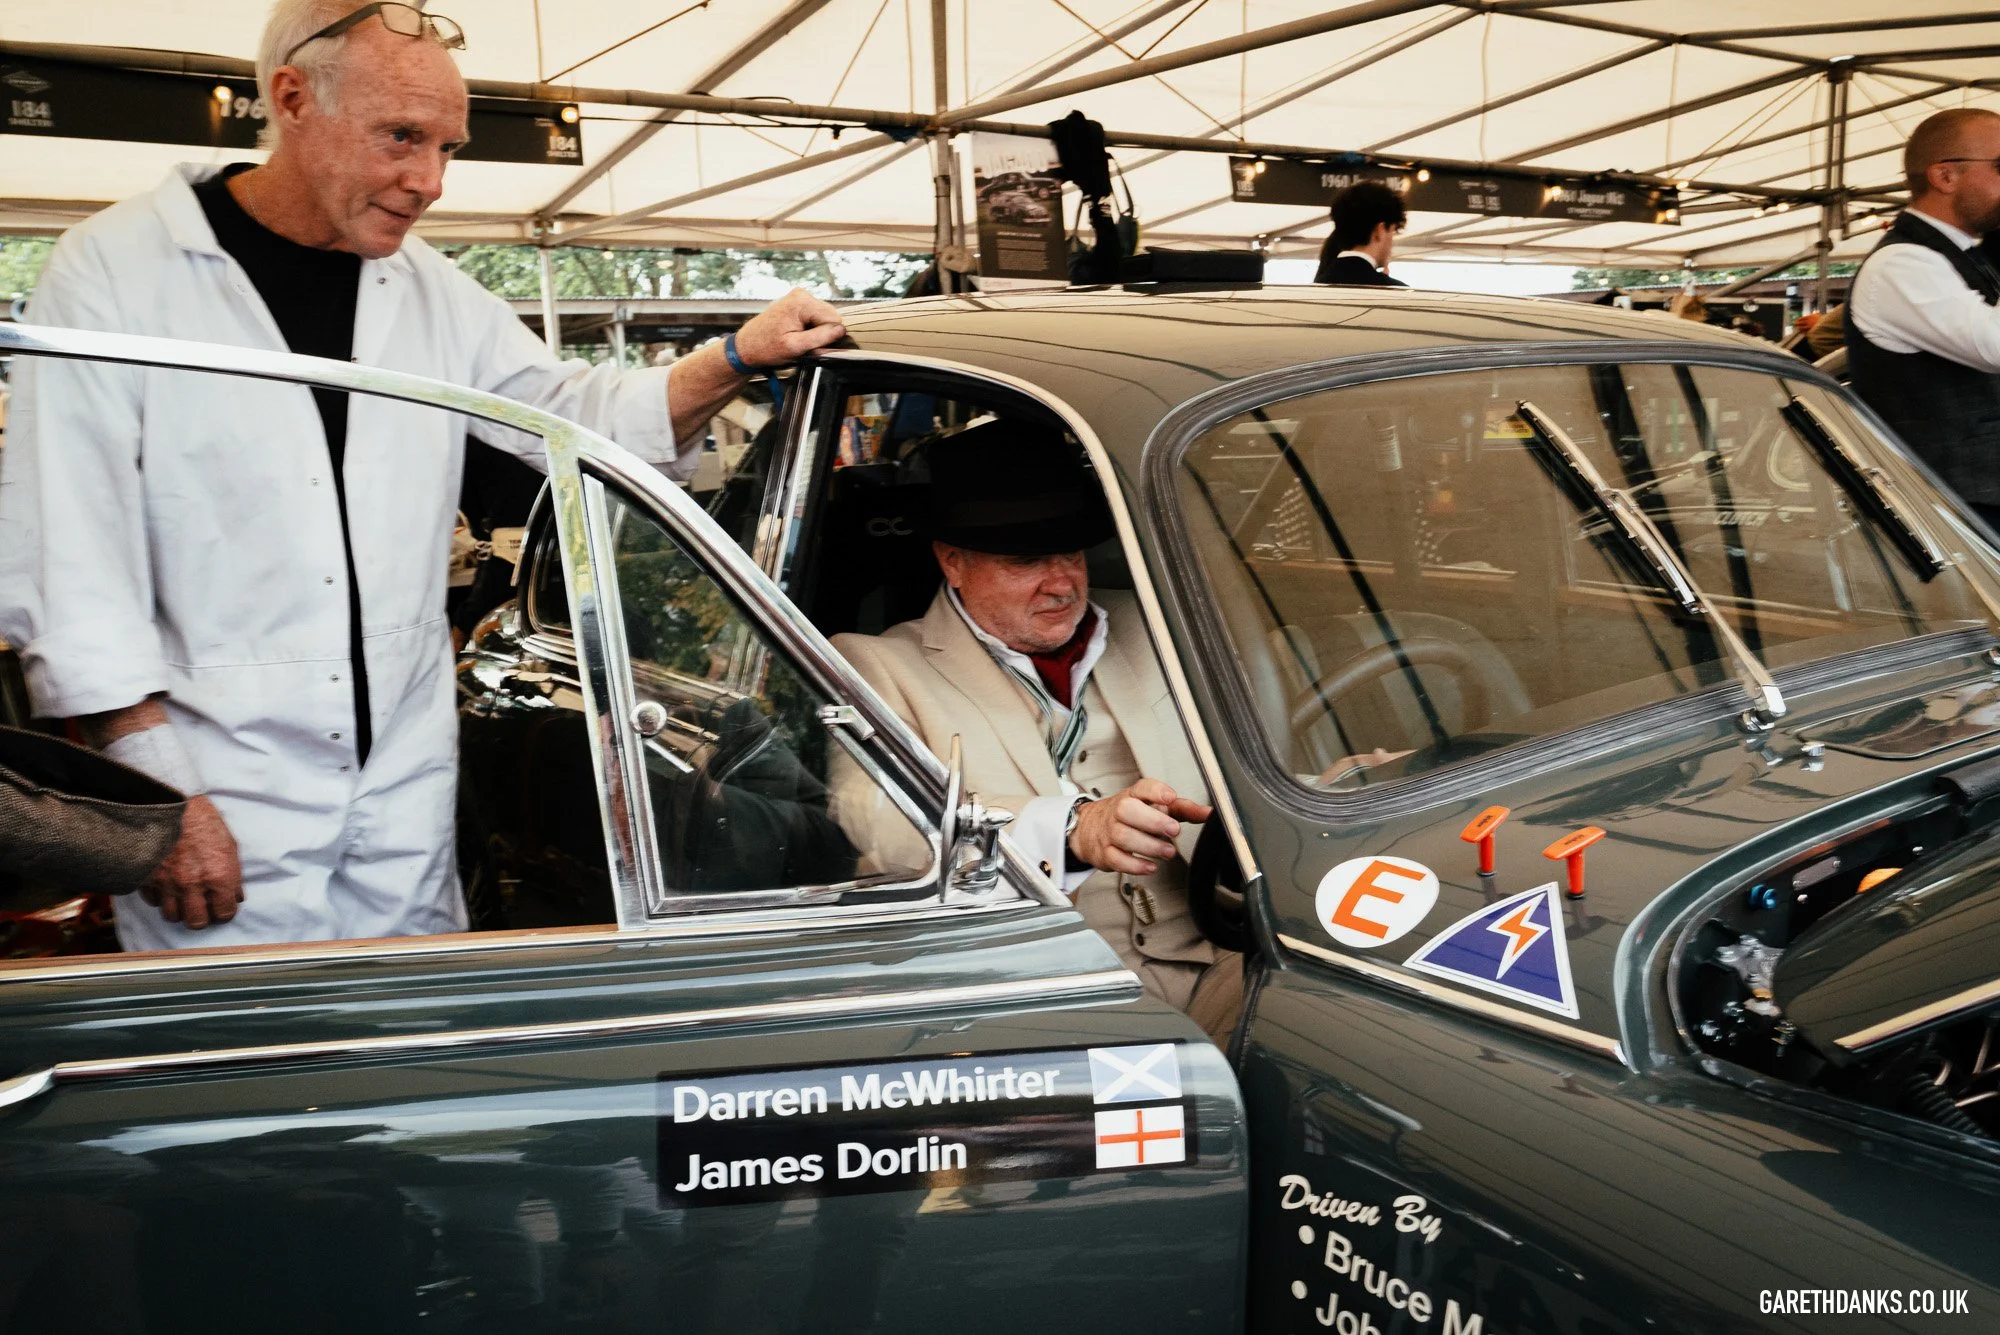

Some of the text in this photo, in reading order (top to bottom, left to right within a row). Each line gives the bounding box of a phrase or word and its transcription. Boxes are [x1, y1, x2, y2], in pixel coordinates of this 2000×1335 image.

[12, 100, 51, 118] 184
[1331, 860, 1427, 939] E
[674, 1066, 1060, 1123] Darren McWhirter
[675, 1136, 967, 1192] James Dorlin
[1279, 1174, 1443, 1244] Driven By
[1324, 1230, 1494, 1335] Bruce M
